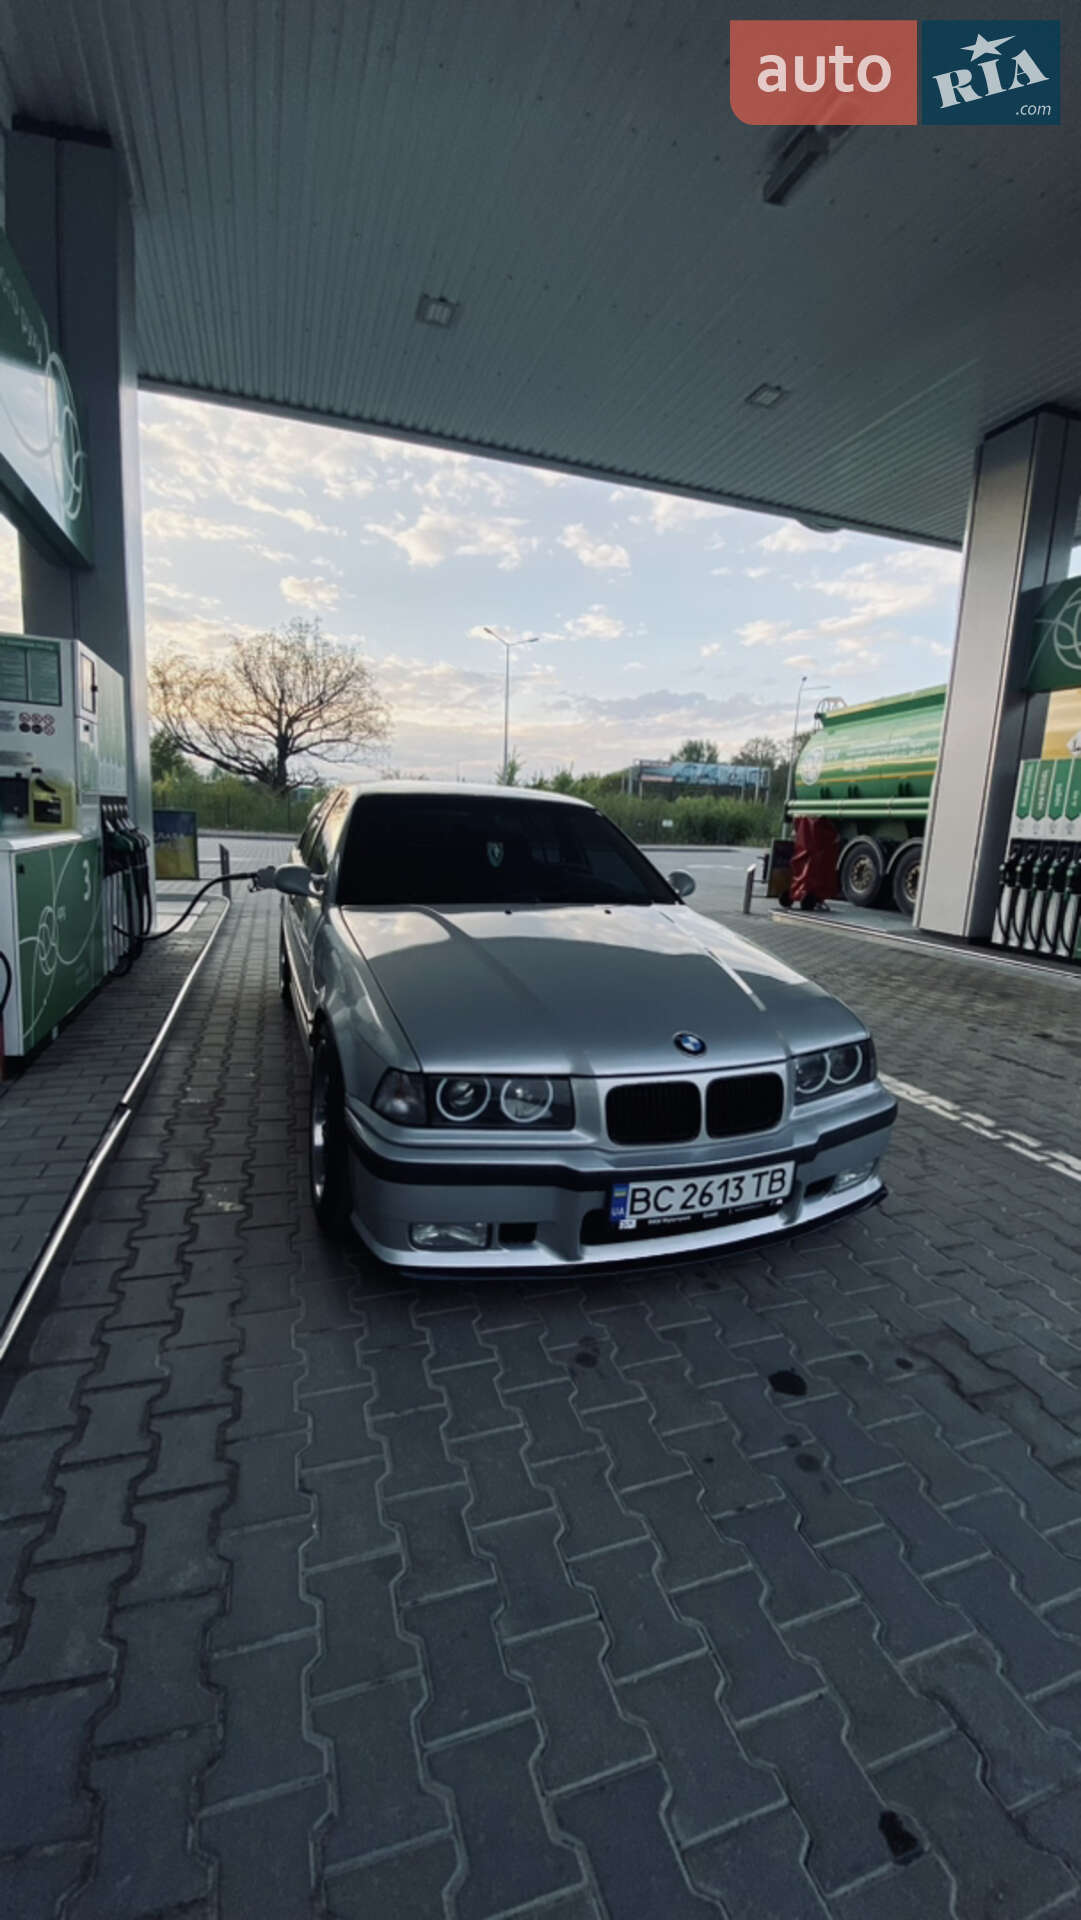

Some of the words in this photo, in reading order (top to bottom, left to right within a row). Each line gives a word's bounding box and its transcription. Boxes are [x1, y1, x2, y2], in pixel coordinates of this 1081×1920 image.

[82, 858, 92, 902] 3
[611, 1207, 625, 1217] UA
[629, 1186, 675, 1216] BC
[679, 1175, 745, 1210] 2613
[752, 1168, 787, 1198] TB
